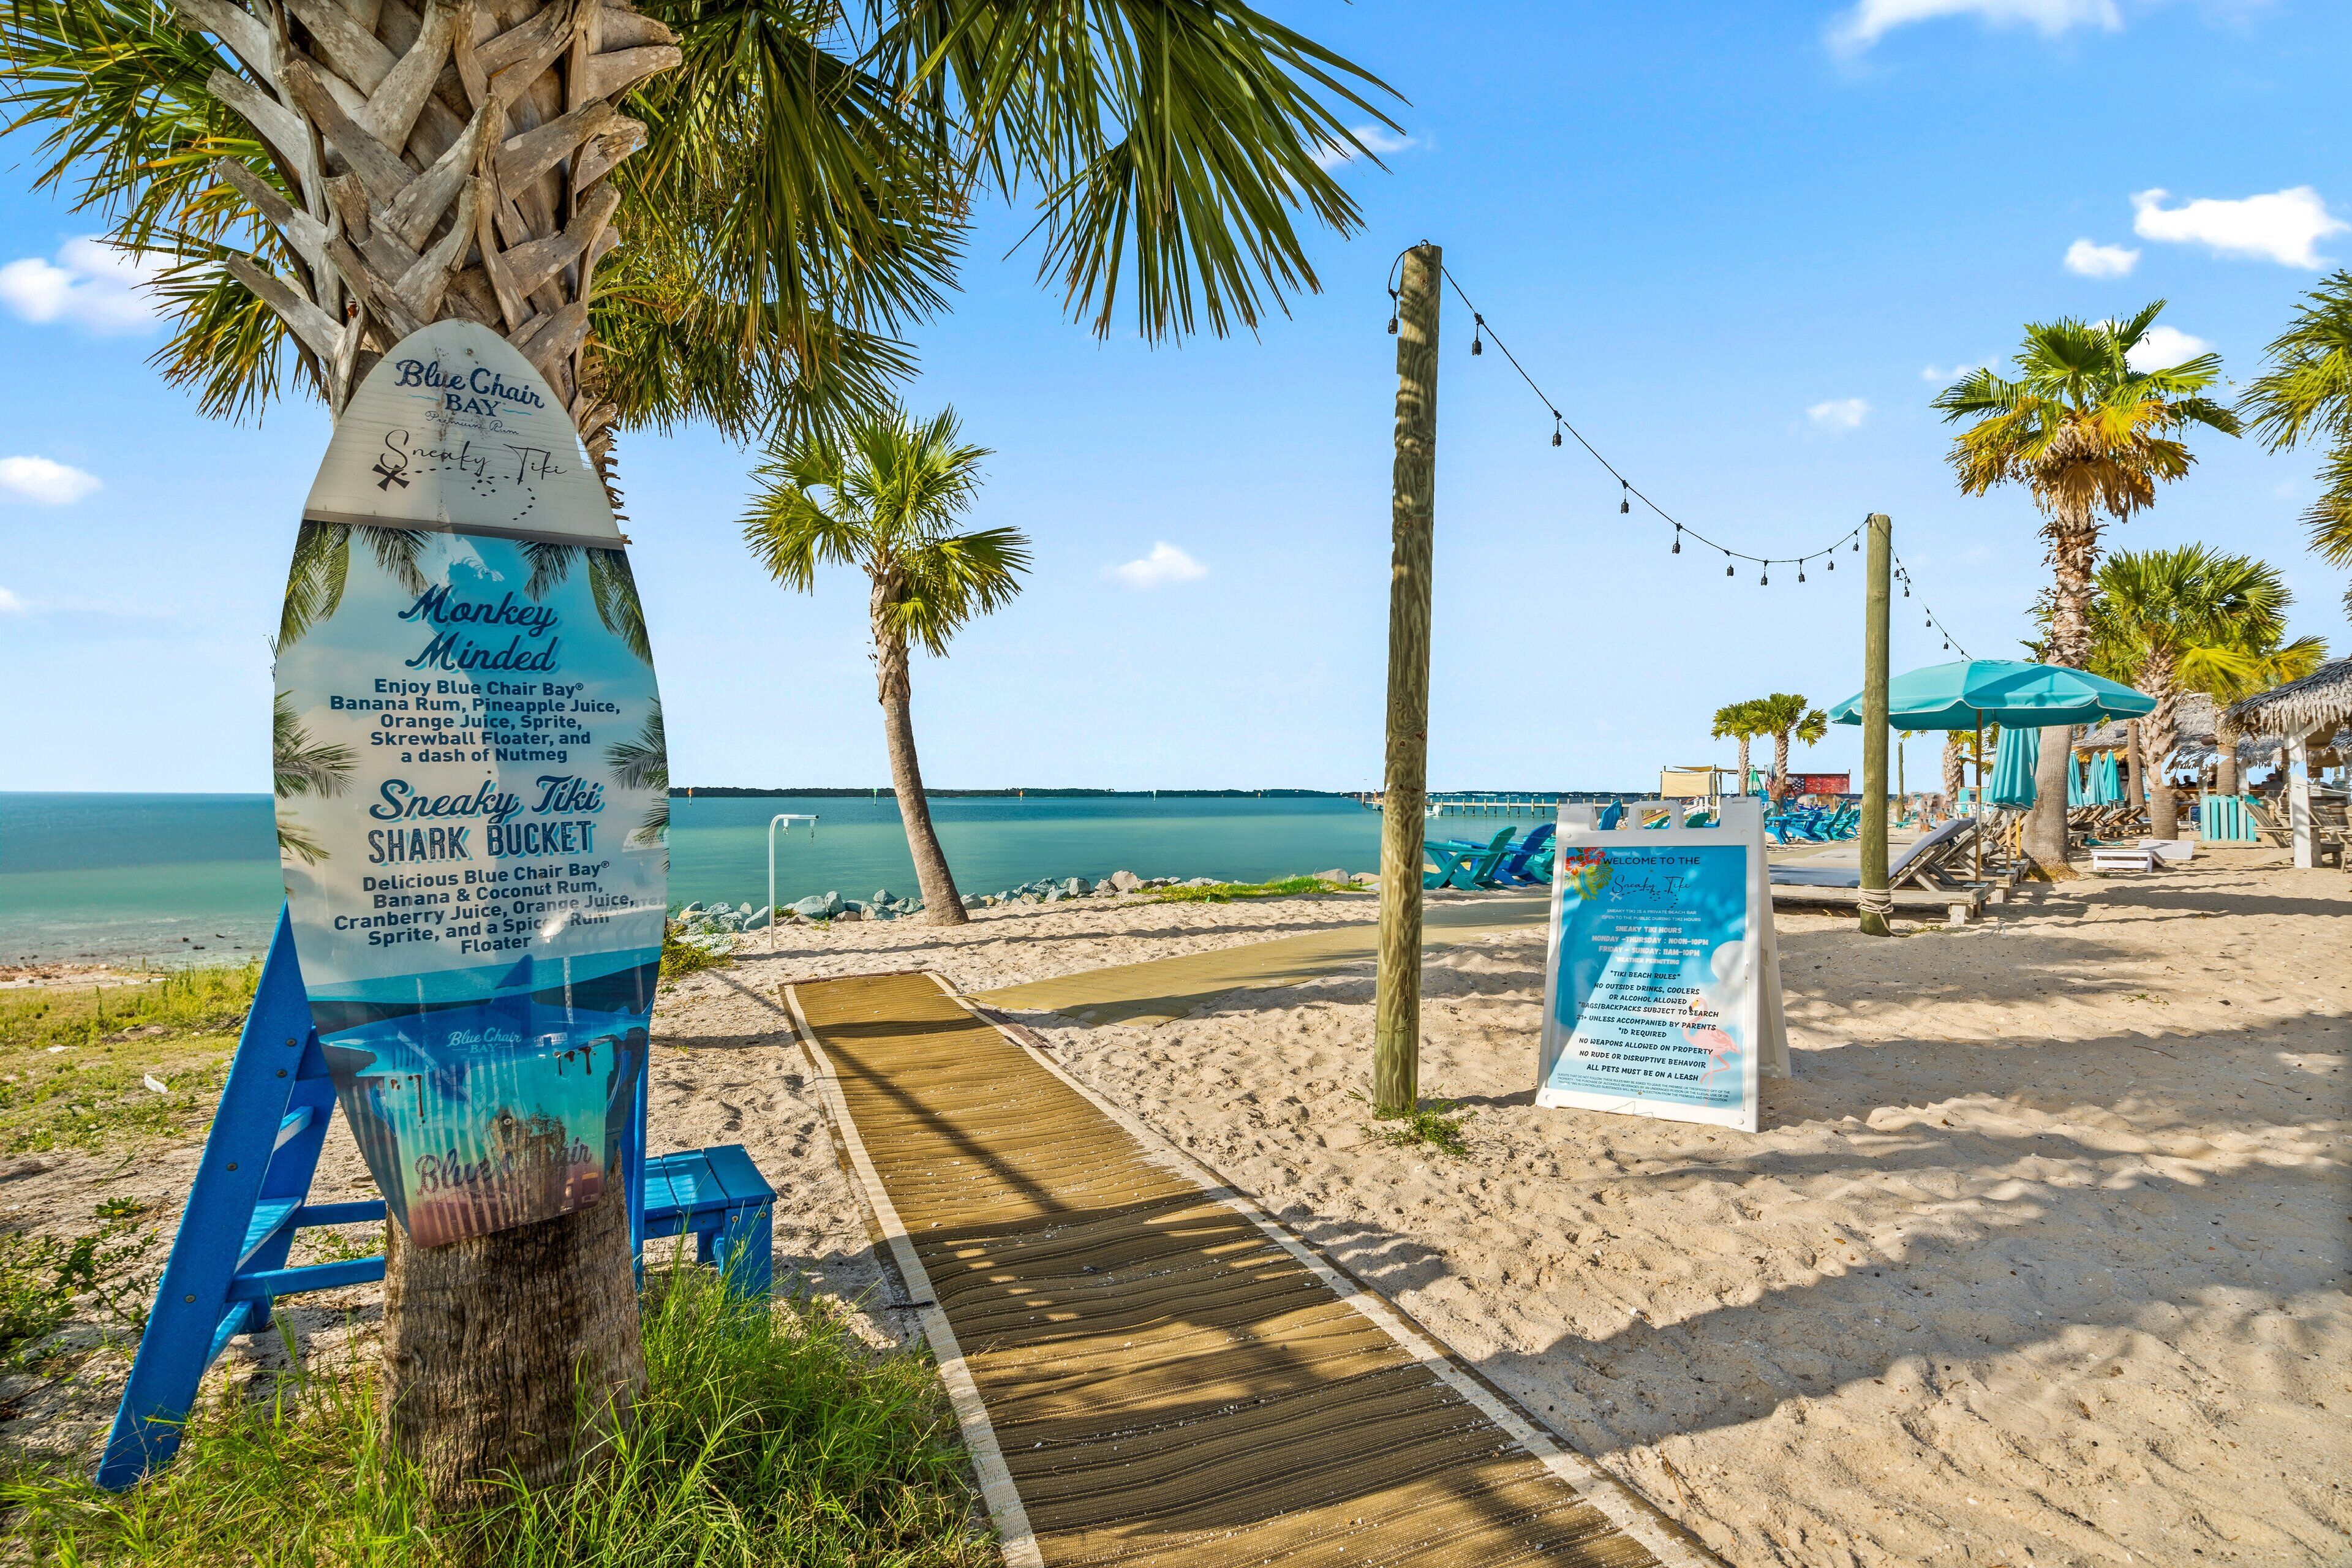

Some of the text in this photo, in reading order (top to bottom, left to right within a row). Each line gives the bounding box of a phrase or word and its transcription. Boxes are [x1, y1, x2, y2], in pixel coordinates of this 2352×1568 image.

[395, 360, 545, 409] Blue Chair
[444, 393, 501, 417] BAY
[425, 411, 519, 435] Premium Rum
[380, 429, 567, 486] Sneaky Tiki
[398, 584, 558, 638] Monkey
[405, 631, 560, 671] Minded
[374, 678, 431, 698] Enjoy
[437, 680, 482, 695] Blue
[486, 681, 537, 696] Chair
[330, 696, 621, 715] Banana Rum, Pineapple Juice,
[380, 714, 582, 733] Orange Juice, Sprite,
[371, 731, 591, 747] Skrewball Floater, and
[400, 748, 568, 765] a dash of Nutmeg
[369, 775, 600, 824] Sneaky Tiki
[369, 820, 591, 864] SHARK BUCKET
[363, 870, 459, 892] Delicious
[464, 869, 508, 884] Blue
[514, 865, 563, 881] Chair
[1612, 875, 1691, 894] Sneaky Tiki
[374, 881, 603, 909] Banana & Coconut Rum,
[334, 911, 444, 931] Cranberry
[451, 904, 507, 921] Juice,
[513, 899, 579, 914] Orange
[584, 894, 634, 908] Juice,
[368, 929, 439, 948] Sprite,
[445, 922, 481, 939] and
[488, 923, 497, 934] a
[570, 913, 610, 927] Rum
[462, 936, 532, 954] Floater
[1637, 985, 1664, 993] DRINKS,
[1616, 1017, 1667, 1027] ACCOMPANIED
[447, 1028, 521, 1047] Blue Chair
[1630, 1029, 1667, 1038] REQUIRED
[470, 1044, 496, 1053] BAY
[1673, 1046, 1713, 1055] PROPERTY
[1623, 1055, 1666, 1064] DISRUPTIVE
[1668, 1058, 1706, 1068] BEHAVOIR
